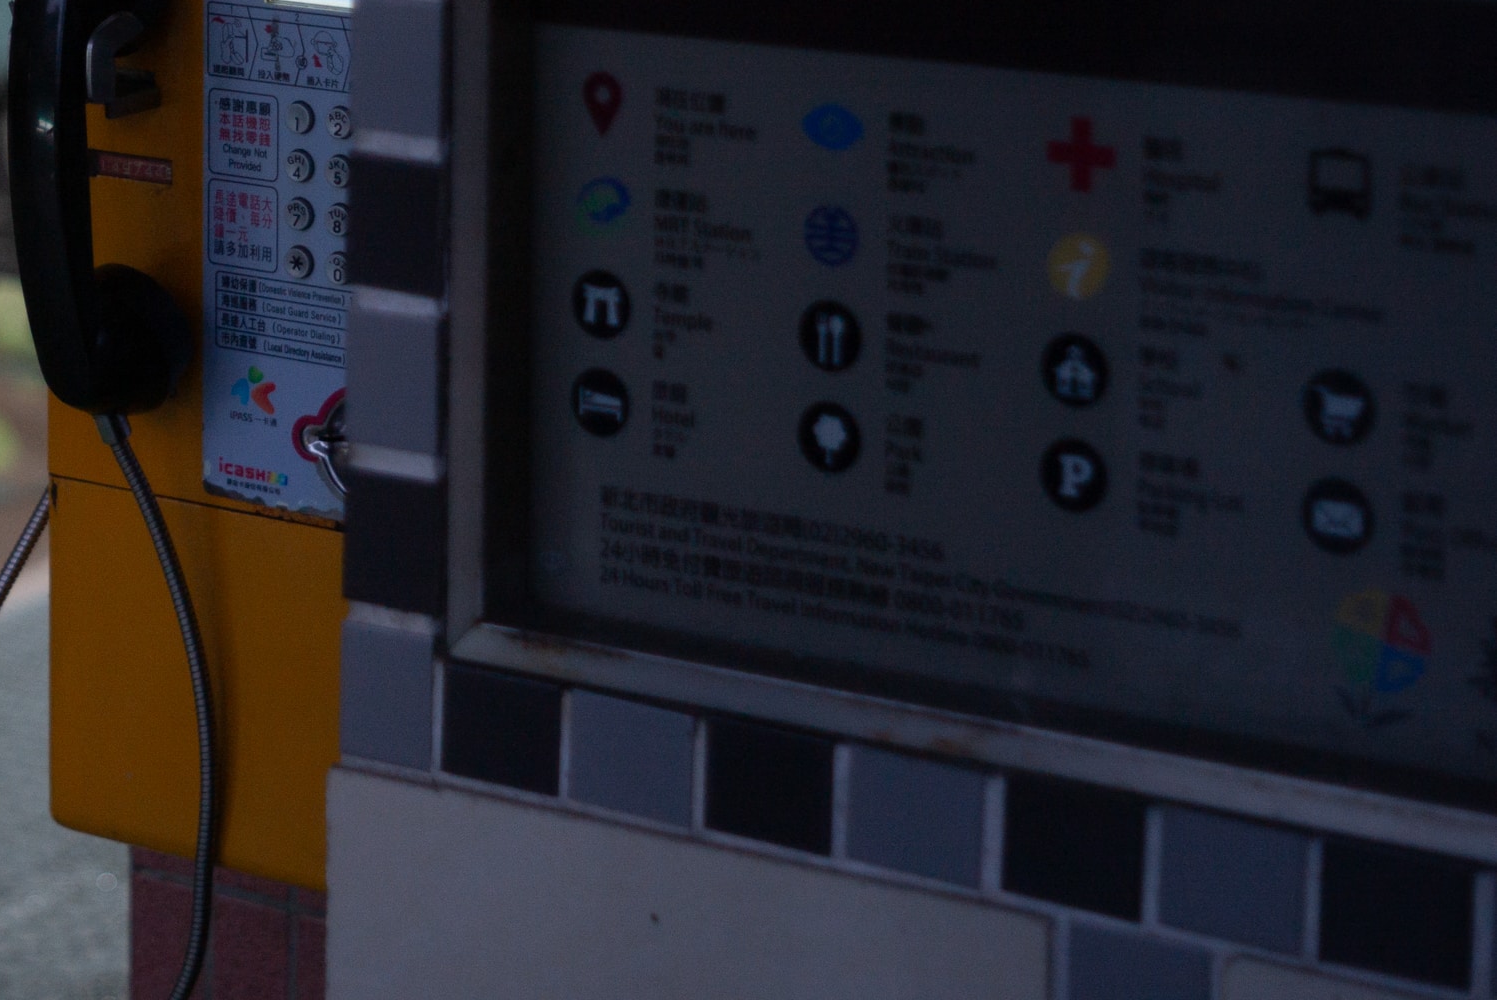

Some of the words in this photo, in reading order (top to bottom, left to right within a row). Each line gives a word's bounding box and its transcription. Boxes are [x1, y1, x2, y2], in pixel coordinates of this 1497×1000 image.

[219, 97, 271, 116] 感謝惠顧
[219, 113, 271, 131] 本話機恕
[295, 117, 299, 131] 1
[328, 111, 348, 123] ABC
[333, 122, 342, 134] 2
[219, 127, 271, 147] 無找零錢
[223, 143, 251, 158] Change
[254, 147, 267, 158] Not
[228, 158, 261, 172] Provided
[287, 155, 305, 165] GHI
[328, 160, 347, 173] JKL
[293, 166, 301, 179] 4
[333, 172, 342, 184] 5
[293, 214, 301, 226] 7
[333, 220, 341, 233] 8
[214, 239, 272, 262] 請多加利用
[333, 268, 342, 281] 0
[288, 304, 309, 319] Guard
[599, 511, 655, 540] Tourist
[658, 521, 690, 543] and
[693, 529, 743, 554] Travel
[620, 567, 670, 596] Hours
[671, 575, 703, 601] Toll
[746, 588, 797, 615] Travel
